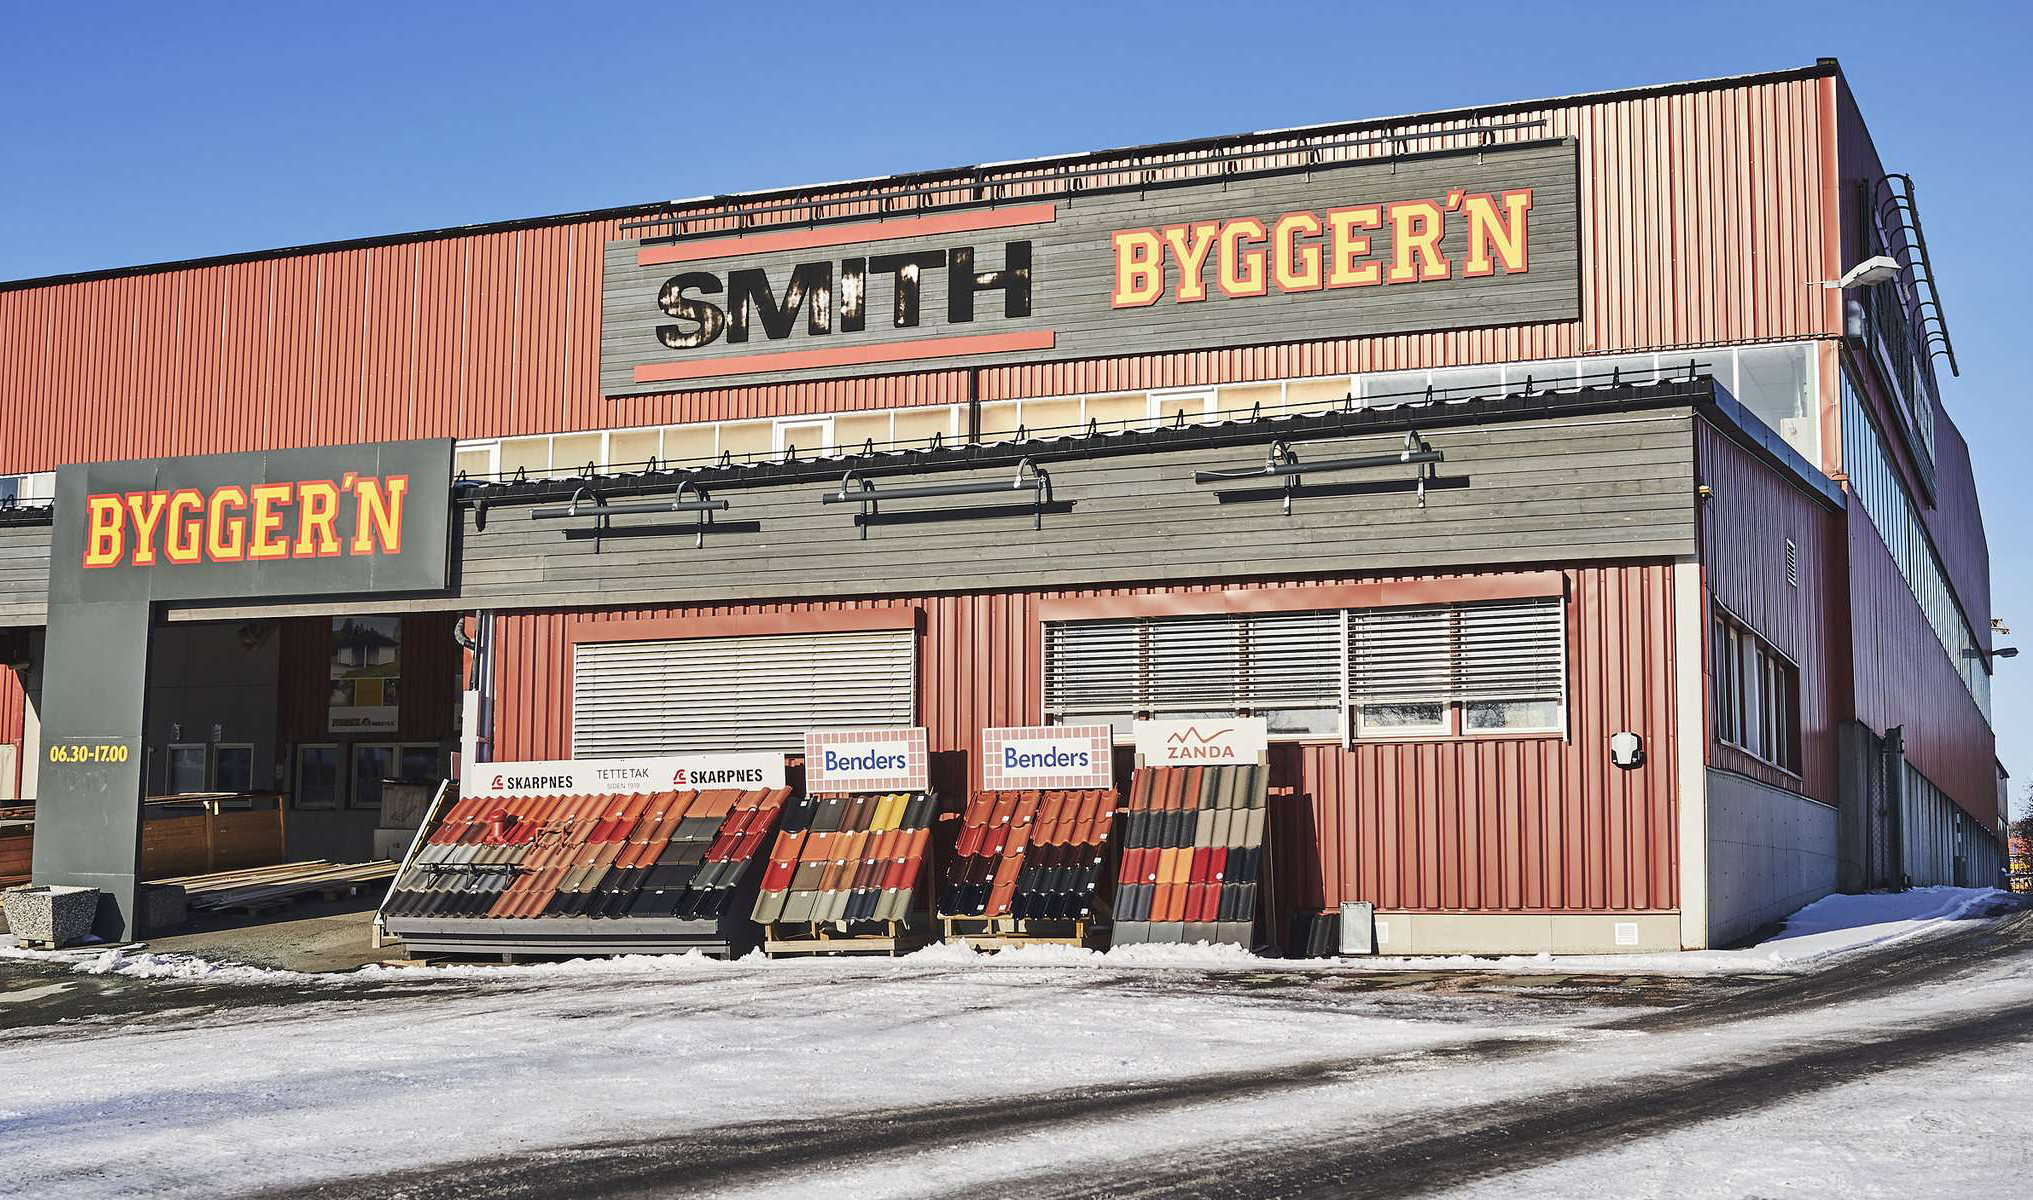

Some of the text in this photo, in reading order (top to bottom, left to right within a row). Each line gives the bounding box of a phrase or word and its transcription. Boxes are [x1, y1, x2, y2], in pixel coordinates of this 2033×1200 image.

[656, 241, 1032, 349] SMITH
[50, 745, 128, 762] 06.30-17.00
[825, 750, 906, 771] Benders
[1004, 747, 1090, 769] Benders
[1168, 747, 1235, 759] ZANDA
[507, 775, 573, 790] SKARPNES
[691, 769, 763, 785] SKARPNES
